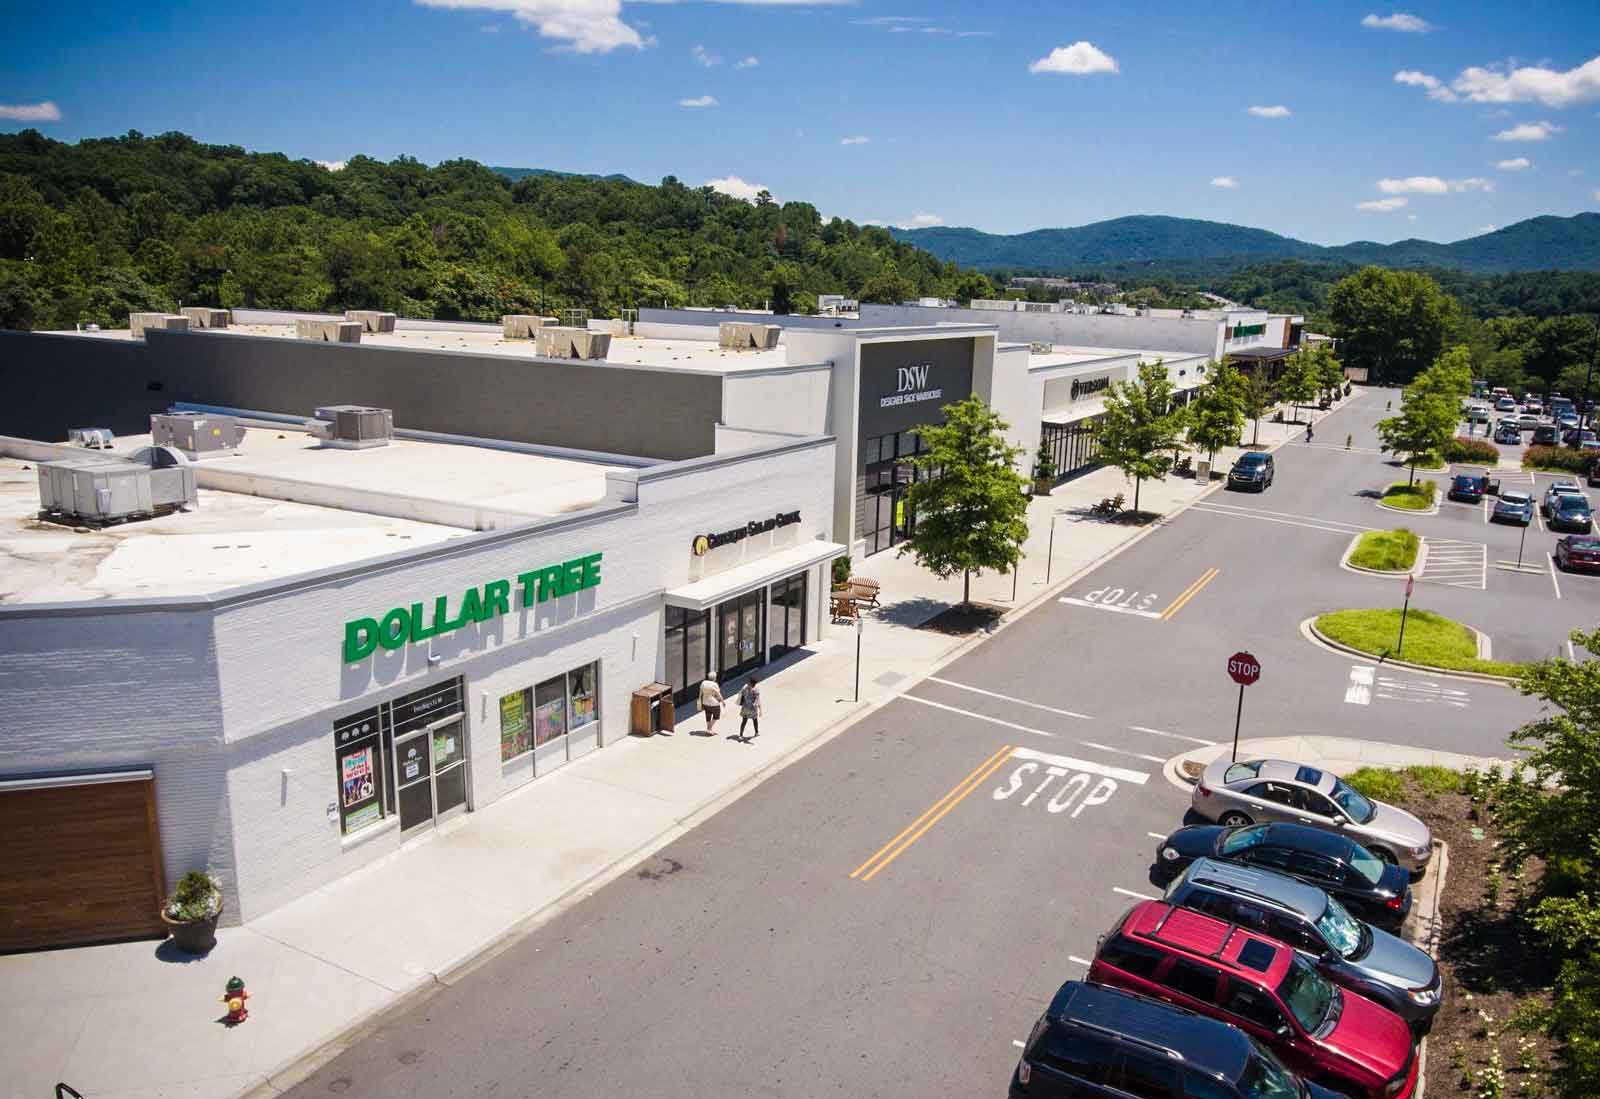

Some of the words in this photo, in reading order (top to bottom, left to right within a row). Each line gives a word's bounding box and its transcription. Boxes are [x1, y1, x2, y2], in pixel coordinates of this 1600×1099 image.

[896, 365, 929, 392] DSW
[345, 579, 510, 664] DOLLAR
[518, 552, 602, 608] TREE
[1085, 586, 1158, 610] STOP
[1229, 660, 1259, 678] STOP
[992, 762, 1118, 818] STOP
